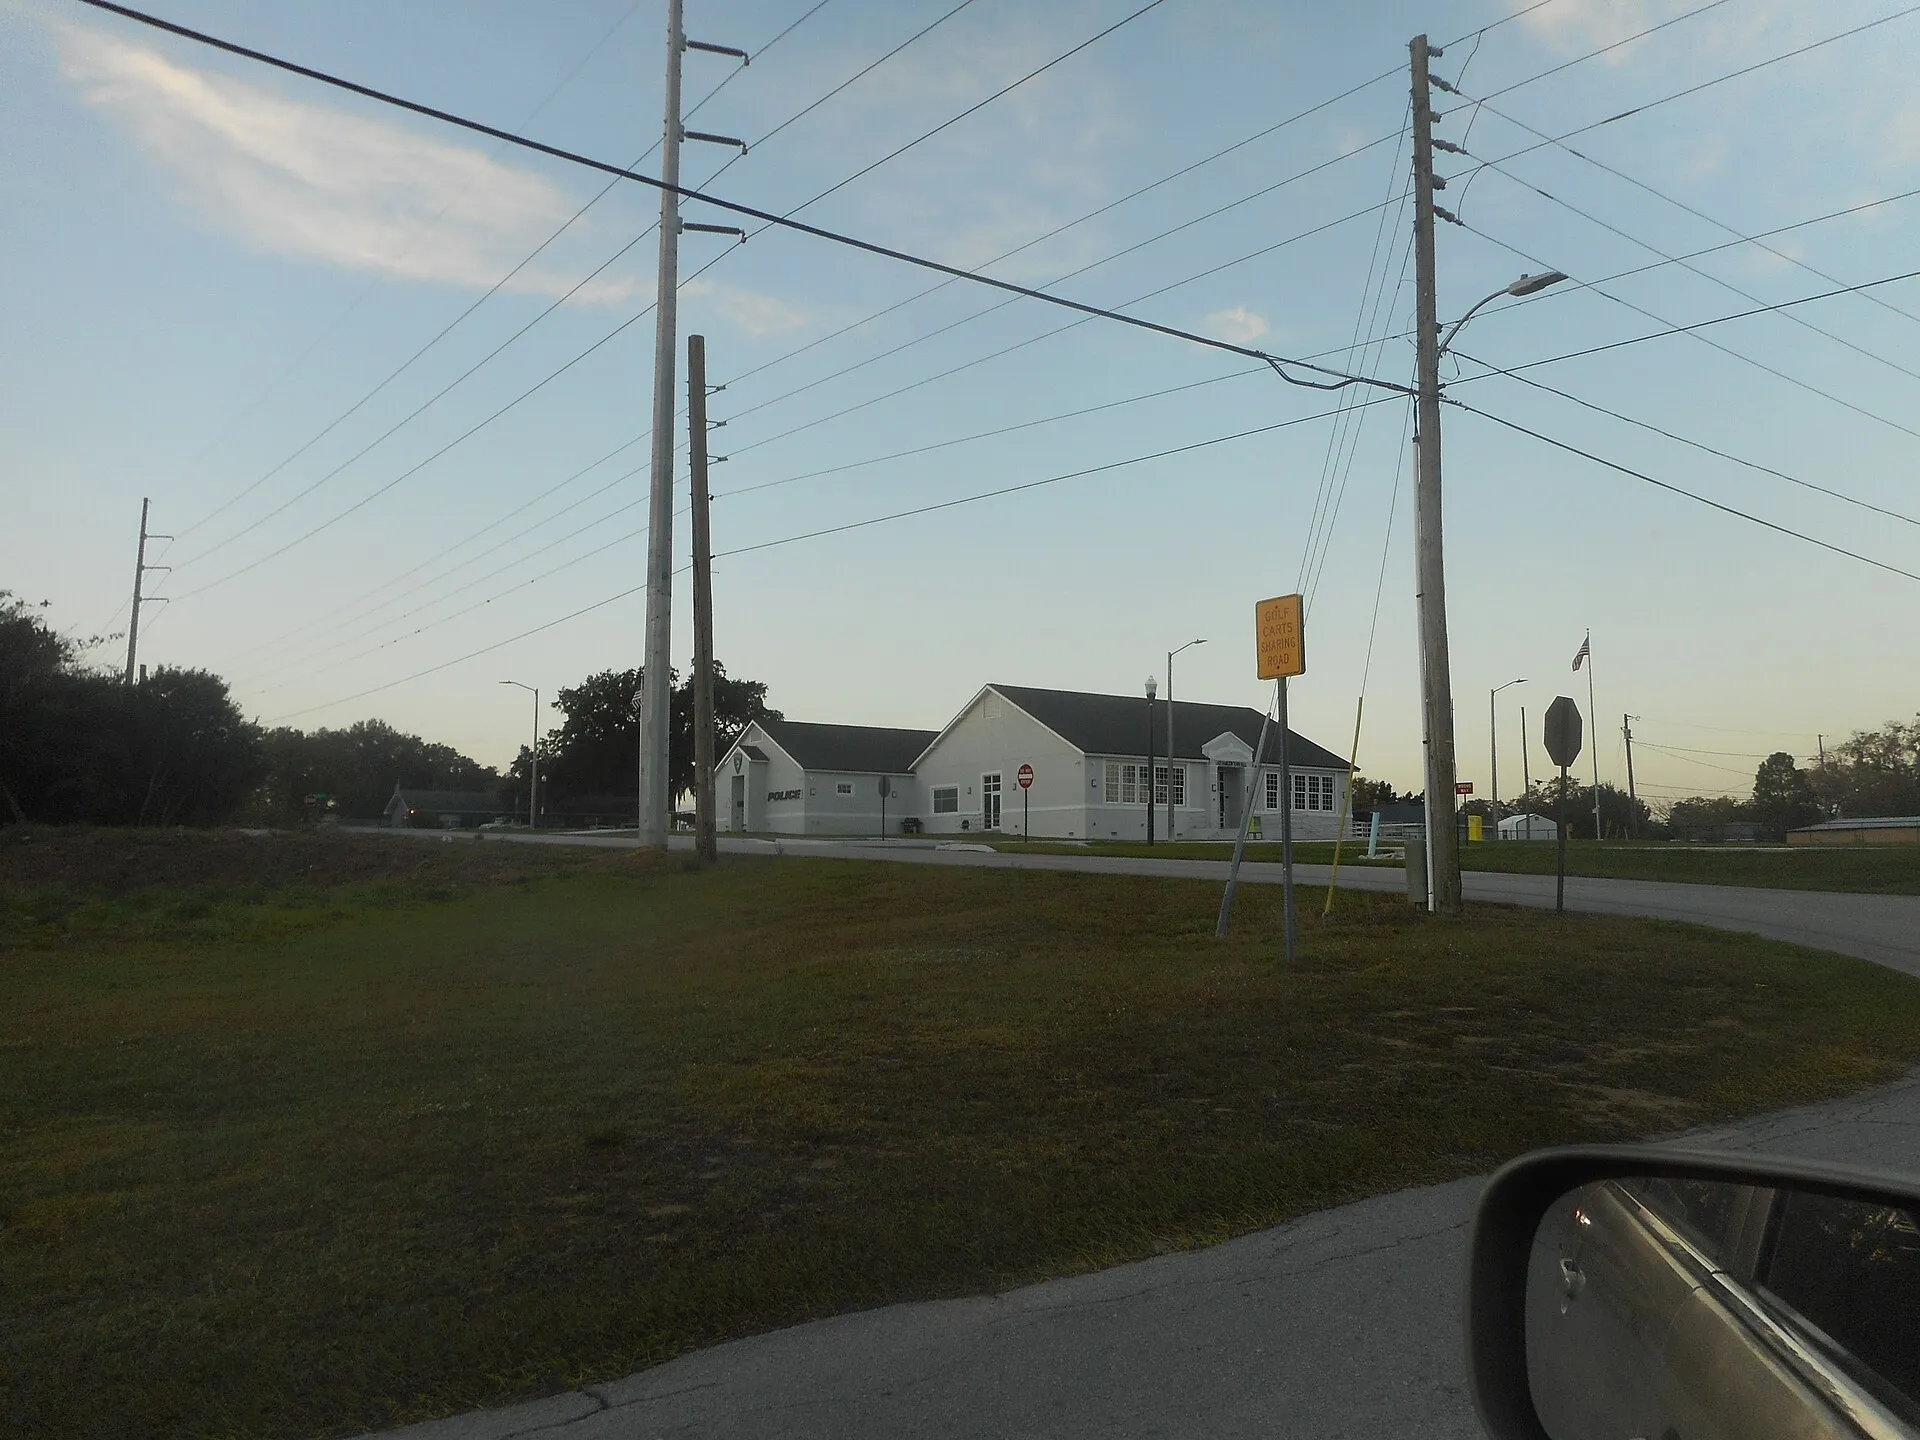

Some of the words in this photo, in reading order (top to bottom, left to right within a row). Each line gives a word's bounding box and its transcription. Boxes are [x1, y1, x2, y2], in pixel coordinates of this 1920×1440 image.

[1264, 607, 1290, 622] GOLF
[1262, 622, 1293, 637] CARTS
[1260, 636, 1296, 653] SHARING
[1267, 653, 1290, 667] ROAD
[767, 789, 801, 802] POLICE
